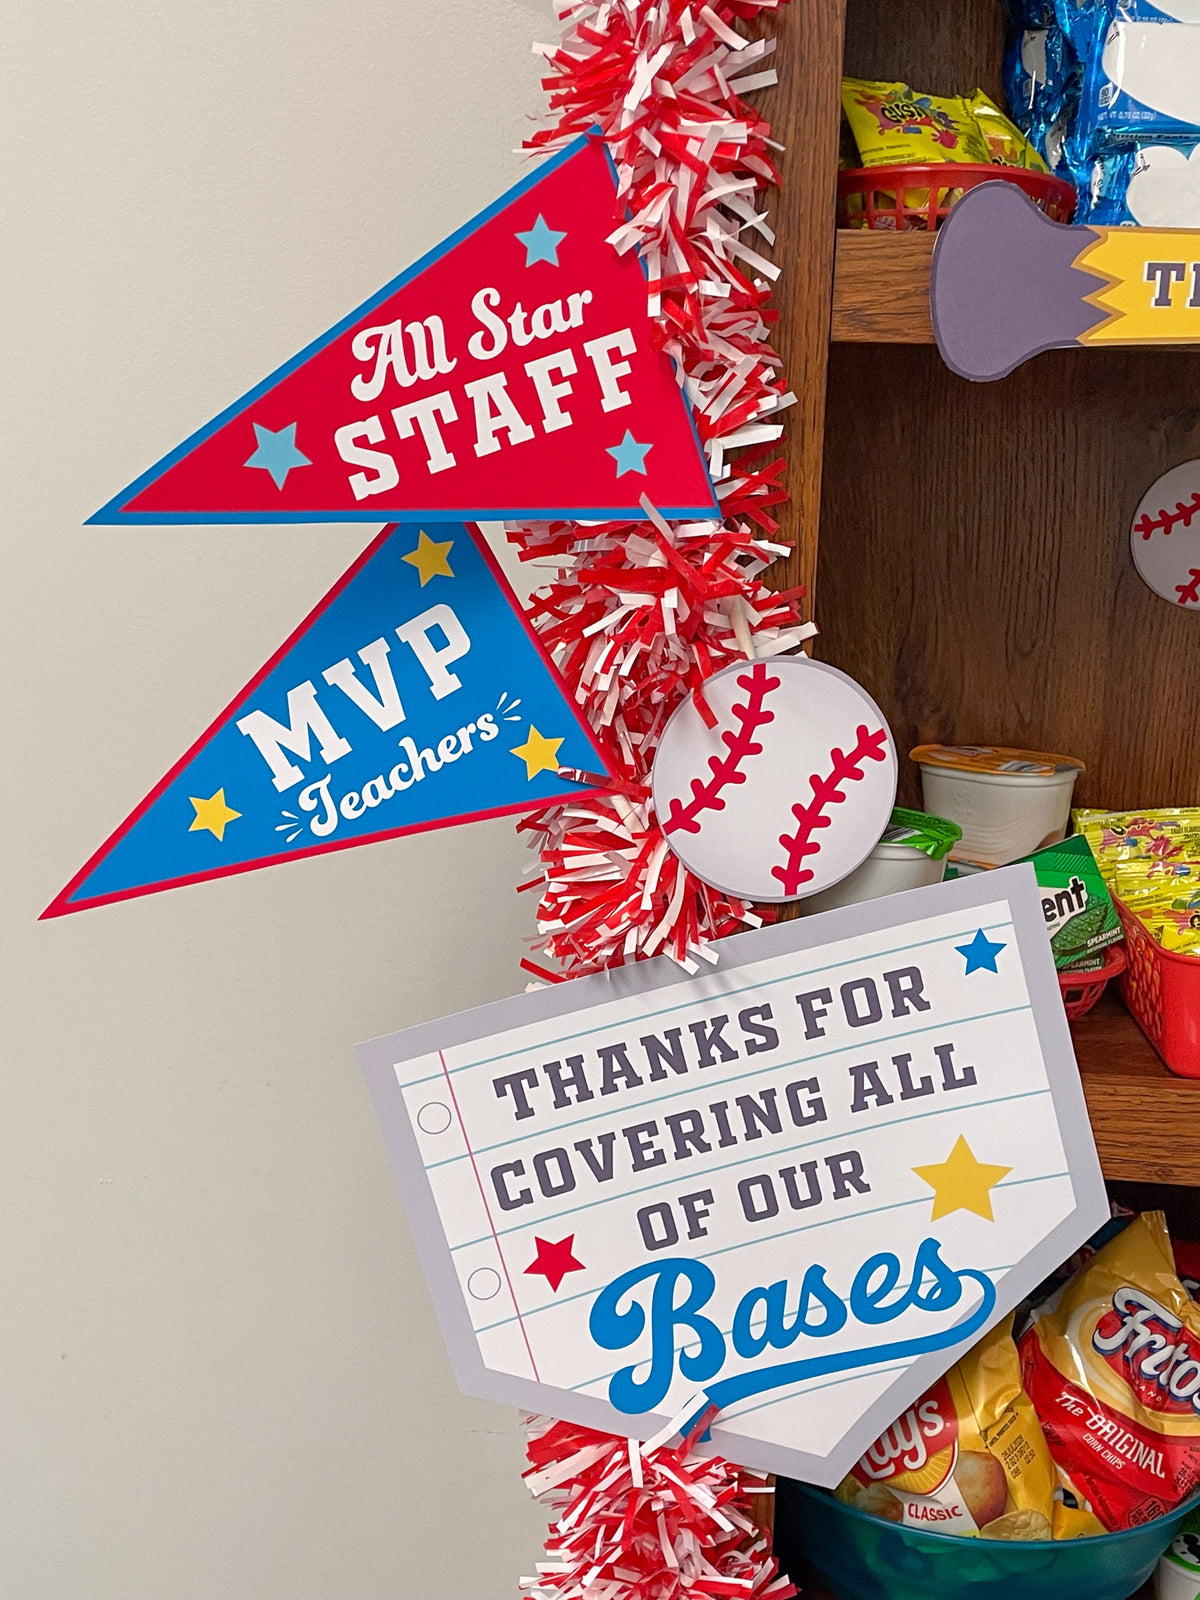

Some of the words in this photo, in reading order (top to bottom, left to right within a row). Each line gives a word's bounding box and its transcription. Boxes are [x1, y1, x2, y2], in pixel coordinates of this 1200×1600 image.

[350, 315, 457, 402] All
[468, 287, 593, 360] Star
[334, 327, 637, 502] STAFF
[235, 603, 471, 793] MVP
[298, 713, 499, 837] Teachers
[1041, 877, 1086, 923] ent
[1086, 926, 1121, 948] SPEARMINT
[493, 1003, 780, 1121] THANKS
[796, 966, 931, 1041] FOR
[490, 1076, 828, 1211] COVERING
[849, 1042, 977, 1114] ALL
[637, 1188, 716, 1252] OF
[737, 1150, 872, 1223] OUR
[589, 1237, 997, 1416] Bases
[860, 1399, 945, 1480] ays
[1055, 1391, 1089, 1417] The
[1082, 1432, 1104, 1453] CORN
[1100, 1449, 1126, 1470] CHIPS
[1085, 1411, 1166, 1479] ORIGINAL
[908, 1503, 963, 1521] CLASSIC
